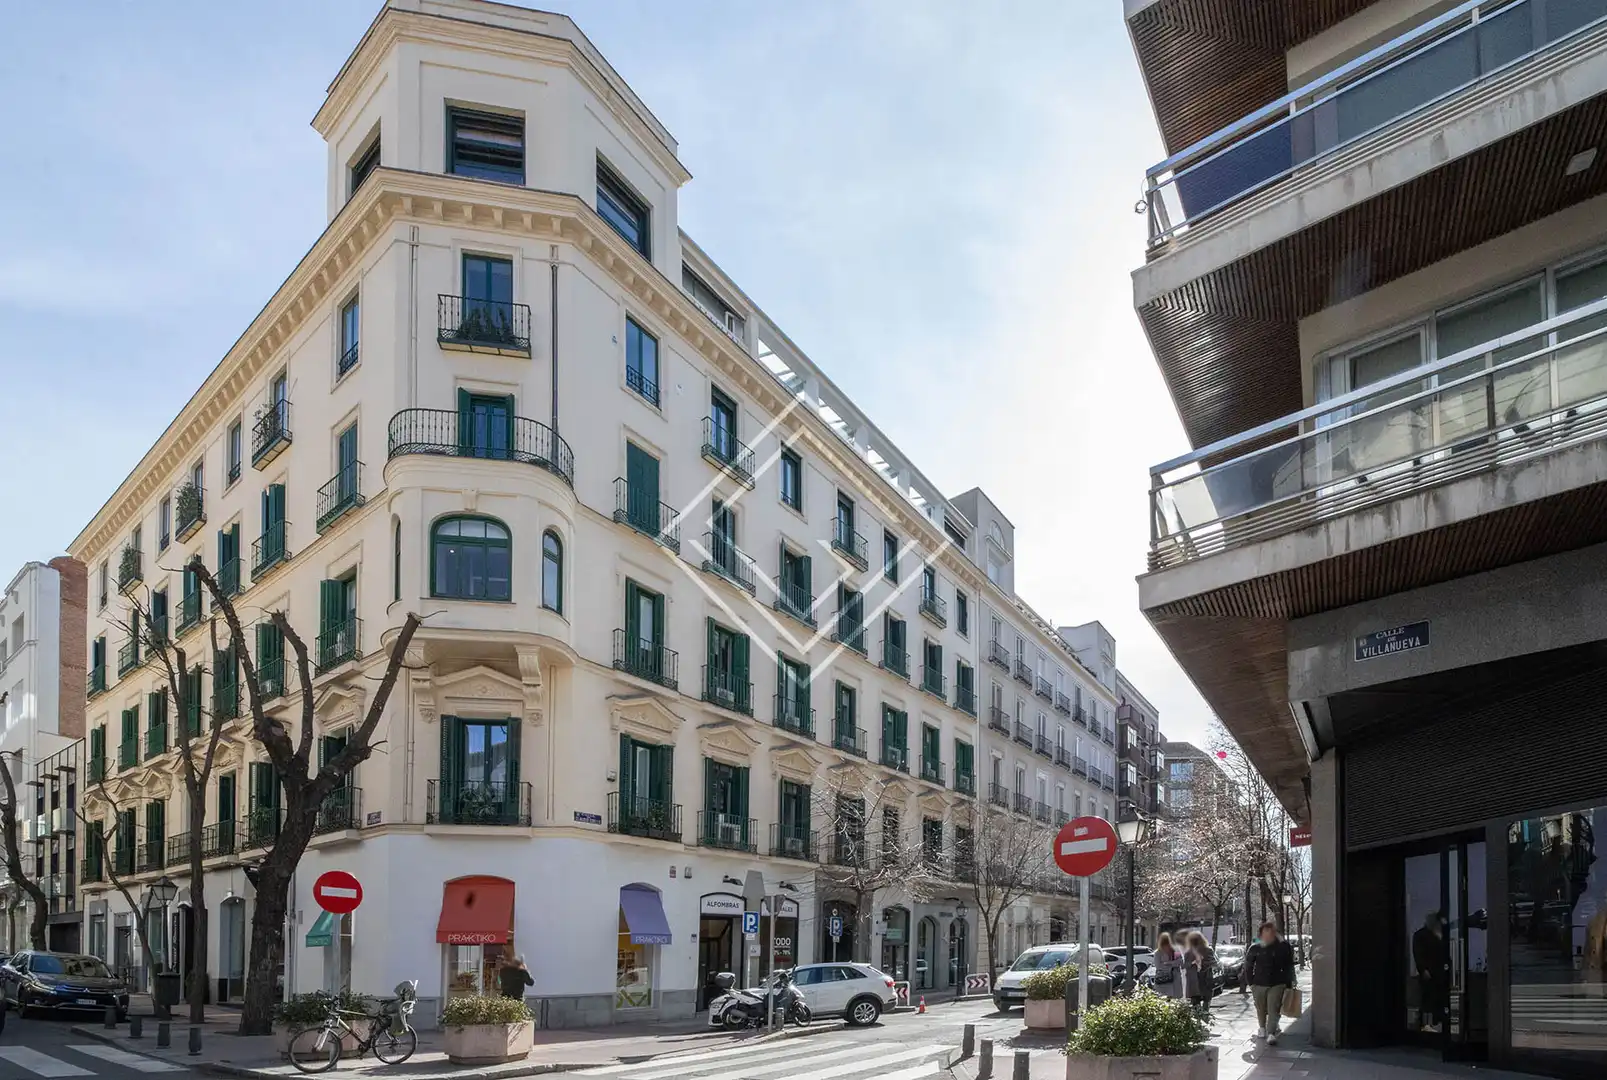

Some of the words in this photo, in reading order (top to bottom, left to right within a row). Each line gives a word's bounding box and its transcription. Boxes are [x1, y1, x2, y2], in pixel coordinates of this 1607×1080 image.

[1376, 627, 1405, 639] CALLE
[1362, 636, 1421, 657] VILLANUEVA
[706, 901, 740, 909] ALFOMBRAS
[447, 933, 496, 943] PRAKTIKO
